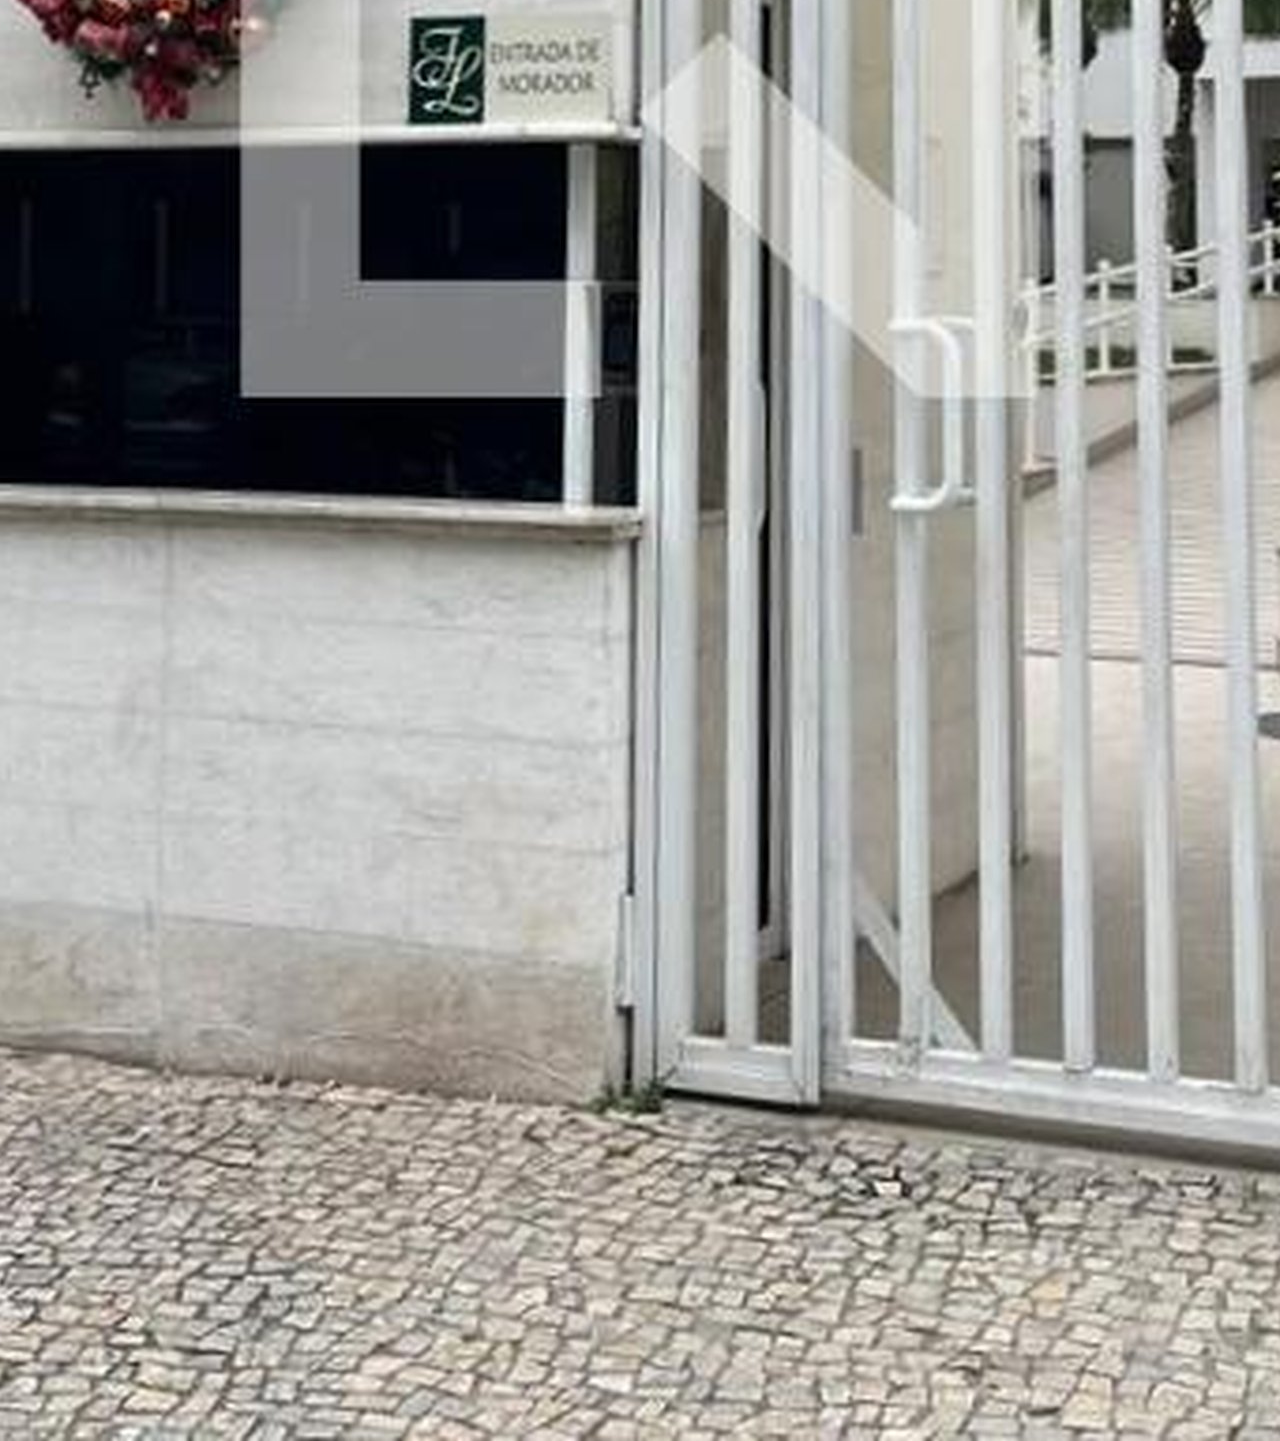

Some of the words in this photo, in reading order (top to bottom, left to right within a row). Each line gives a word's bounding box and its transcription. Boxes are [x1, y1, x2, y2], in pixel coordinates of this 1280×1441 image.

[490, 41, 571, 64] ENTRADA
[576, 39, 601, 62] DE
[499, 72, 596, 95] MORADOR
